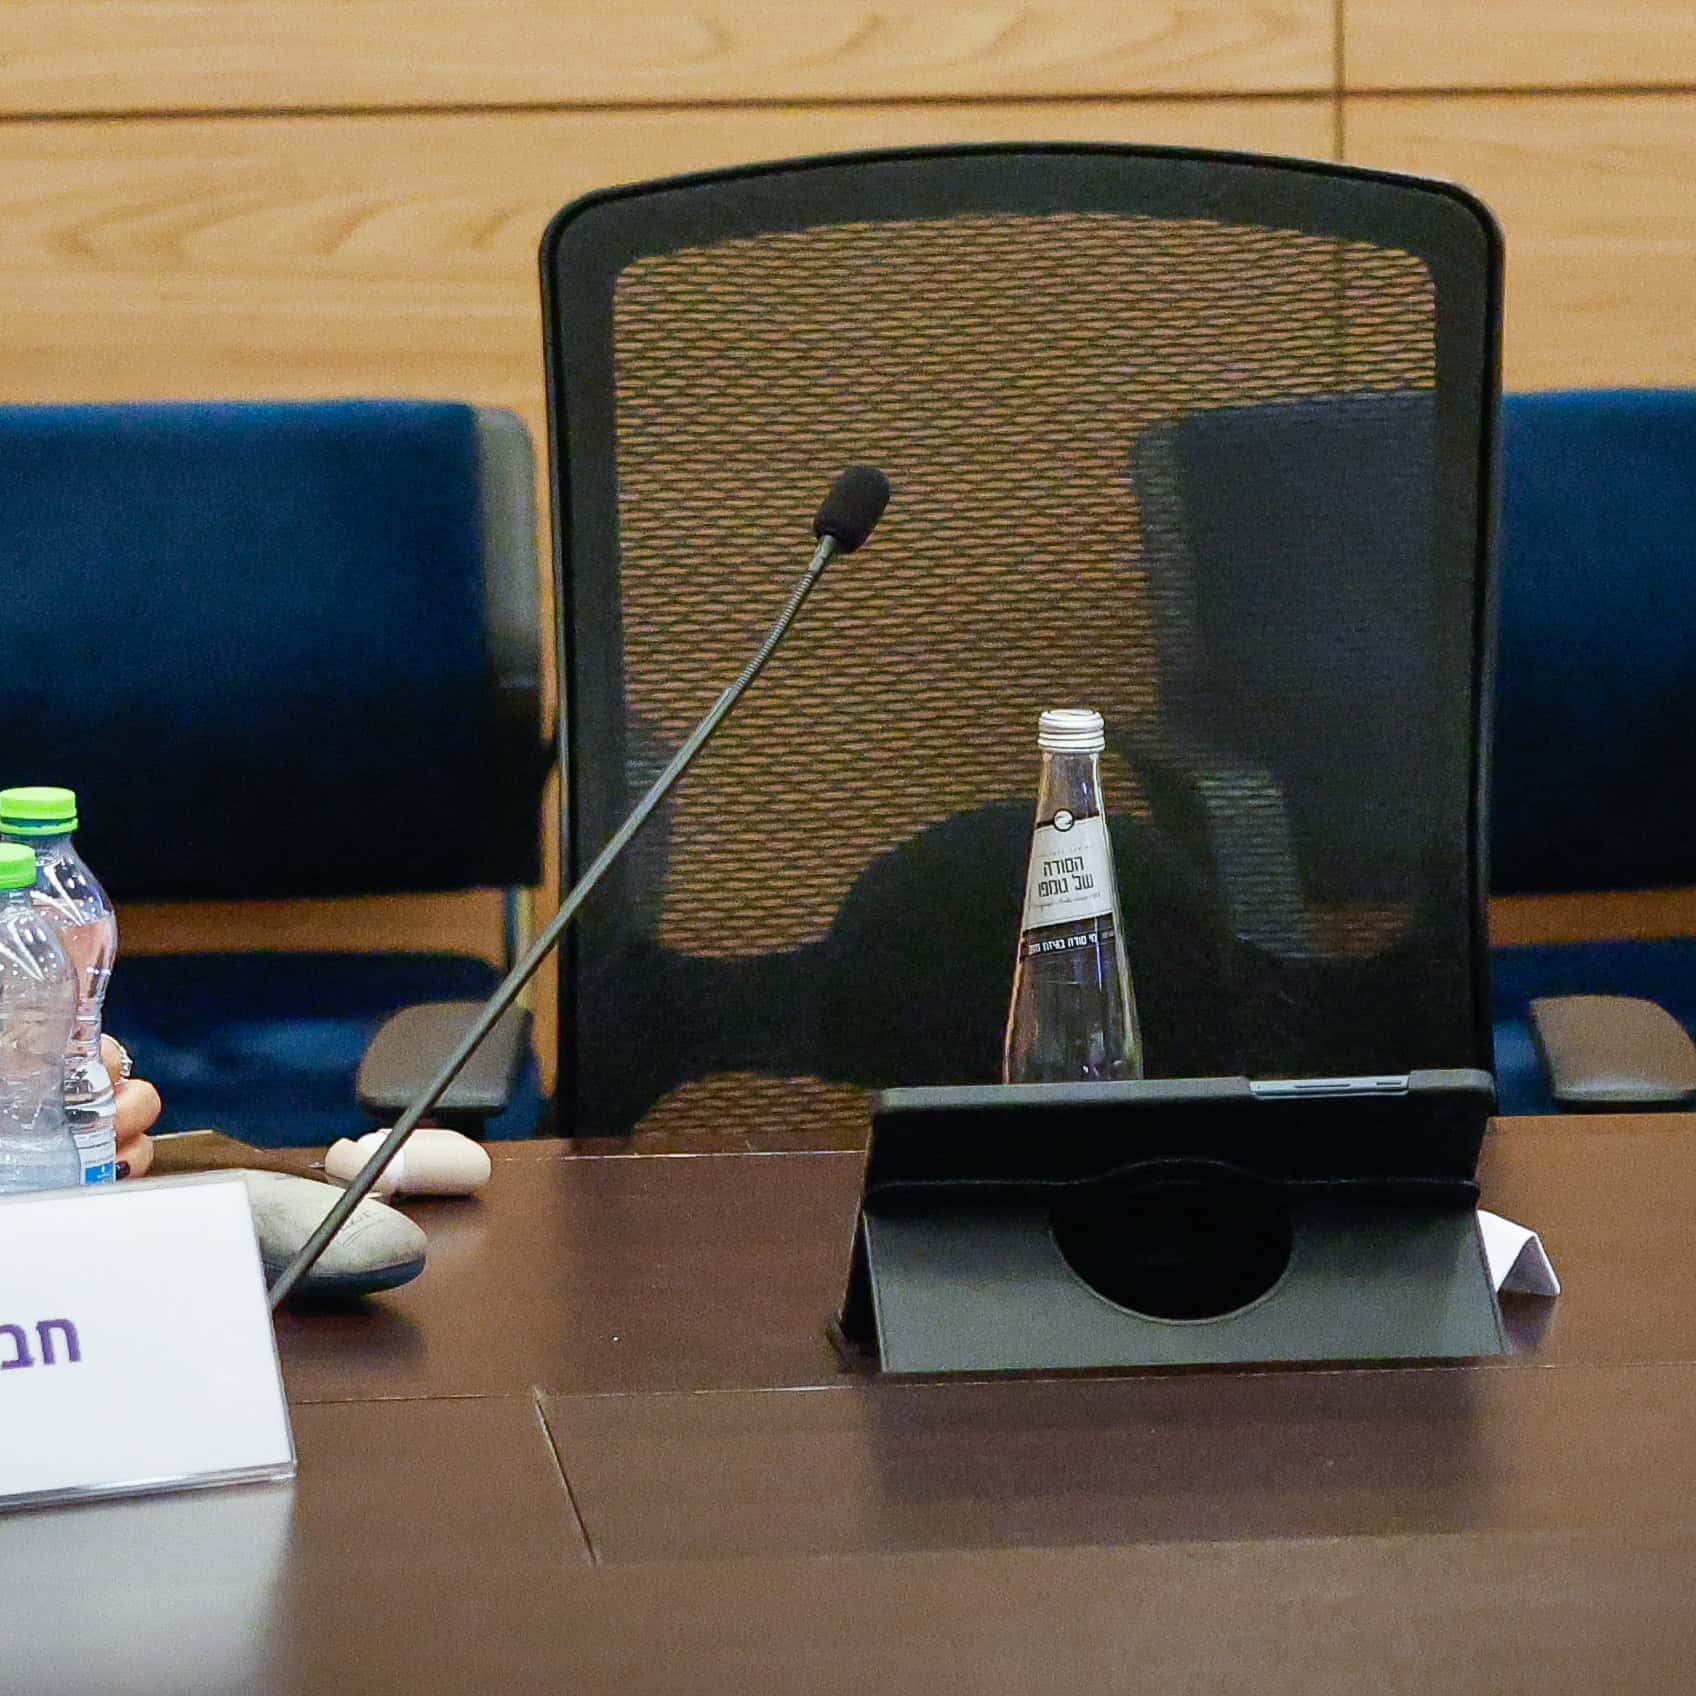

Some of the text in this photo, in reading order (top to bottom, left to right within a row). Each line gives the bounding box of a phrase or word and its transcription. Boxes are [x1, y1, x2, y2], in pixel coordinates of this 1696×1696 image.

[1043, 855, 1084, 877] הסודה
[1038, 873, 1094, 898] של טמפו
